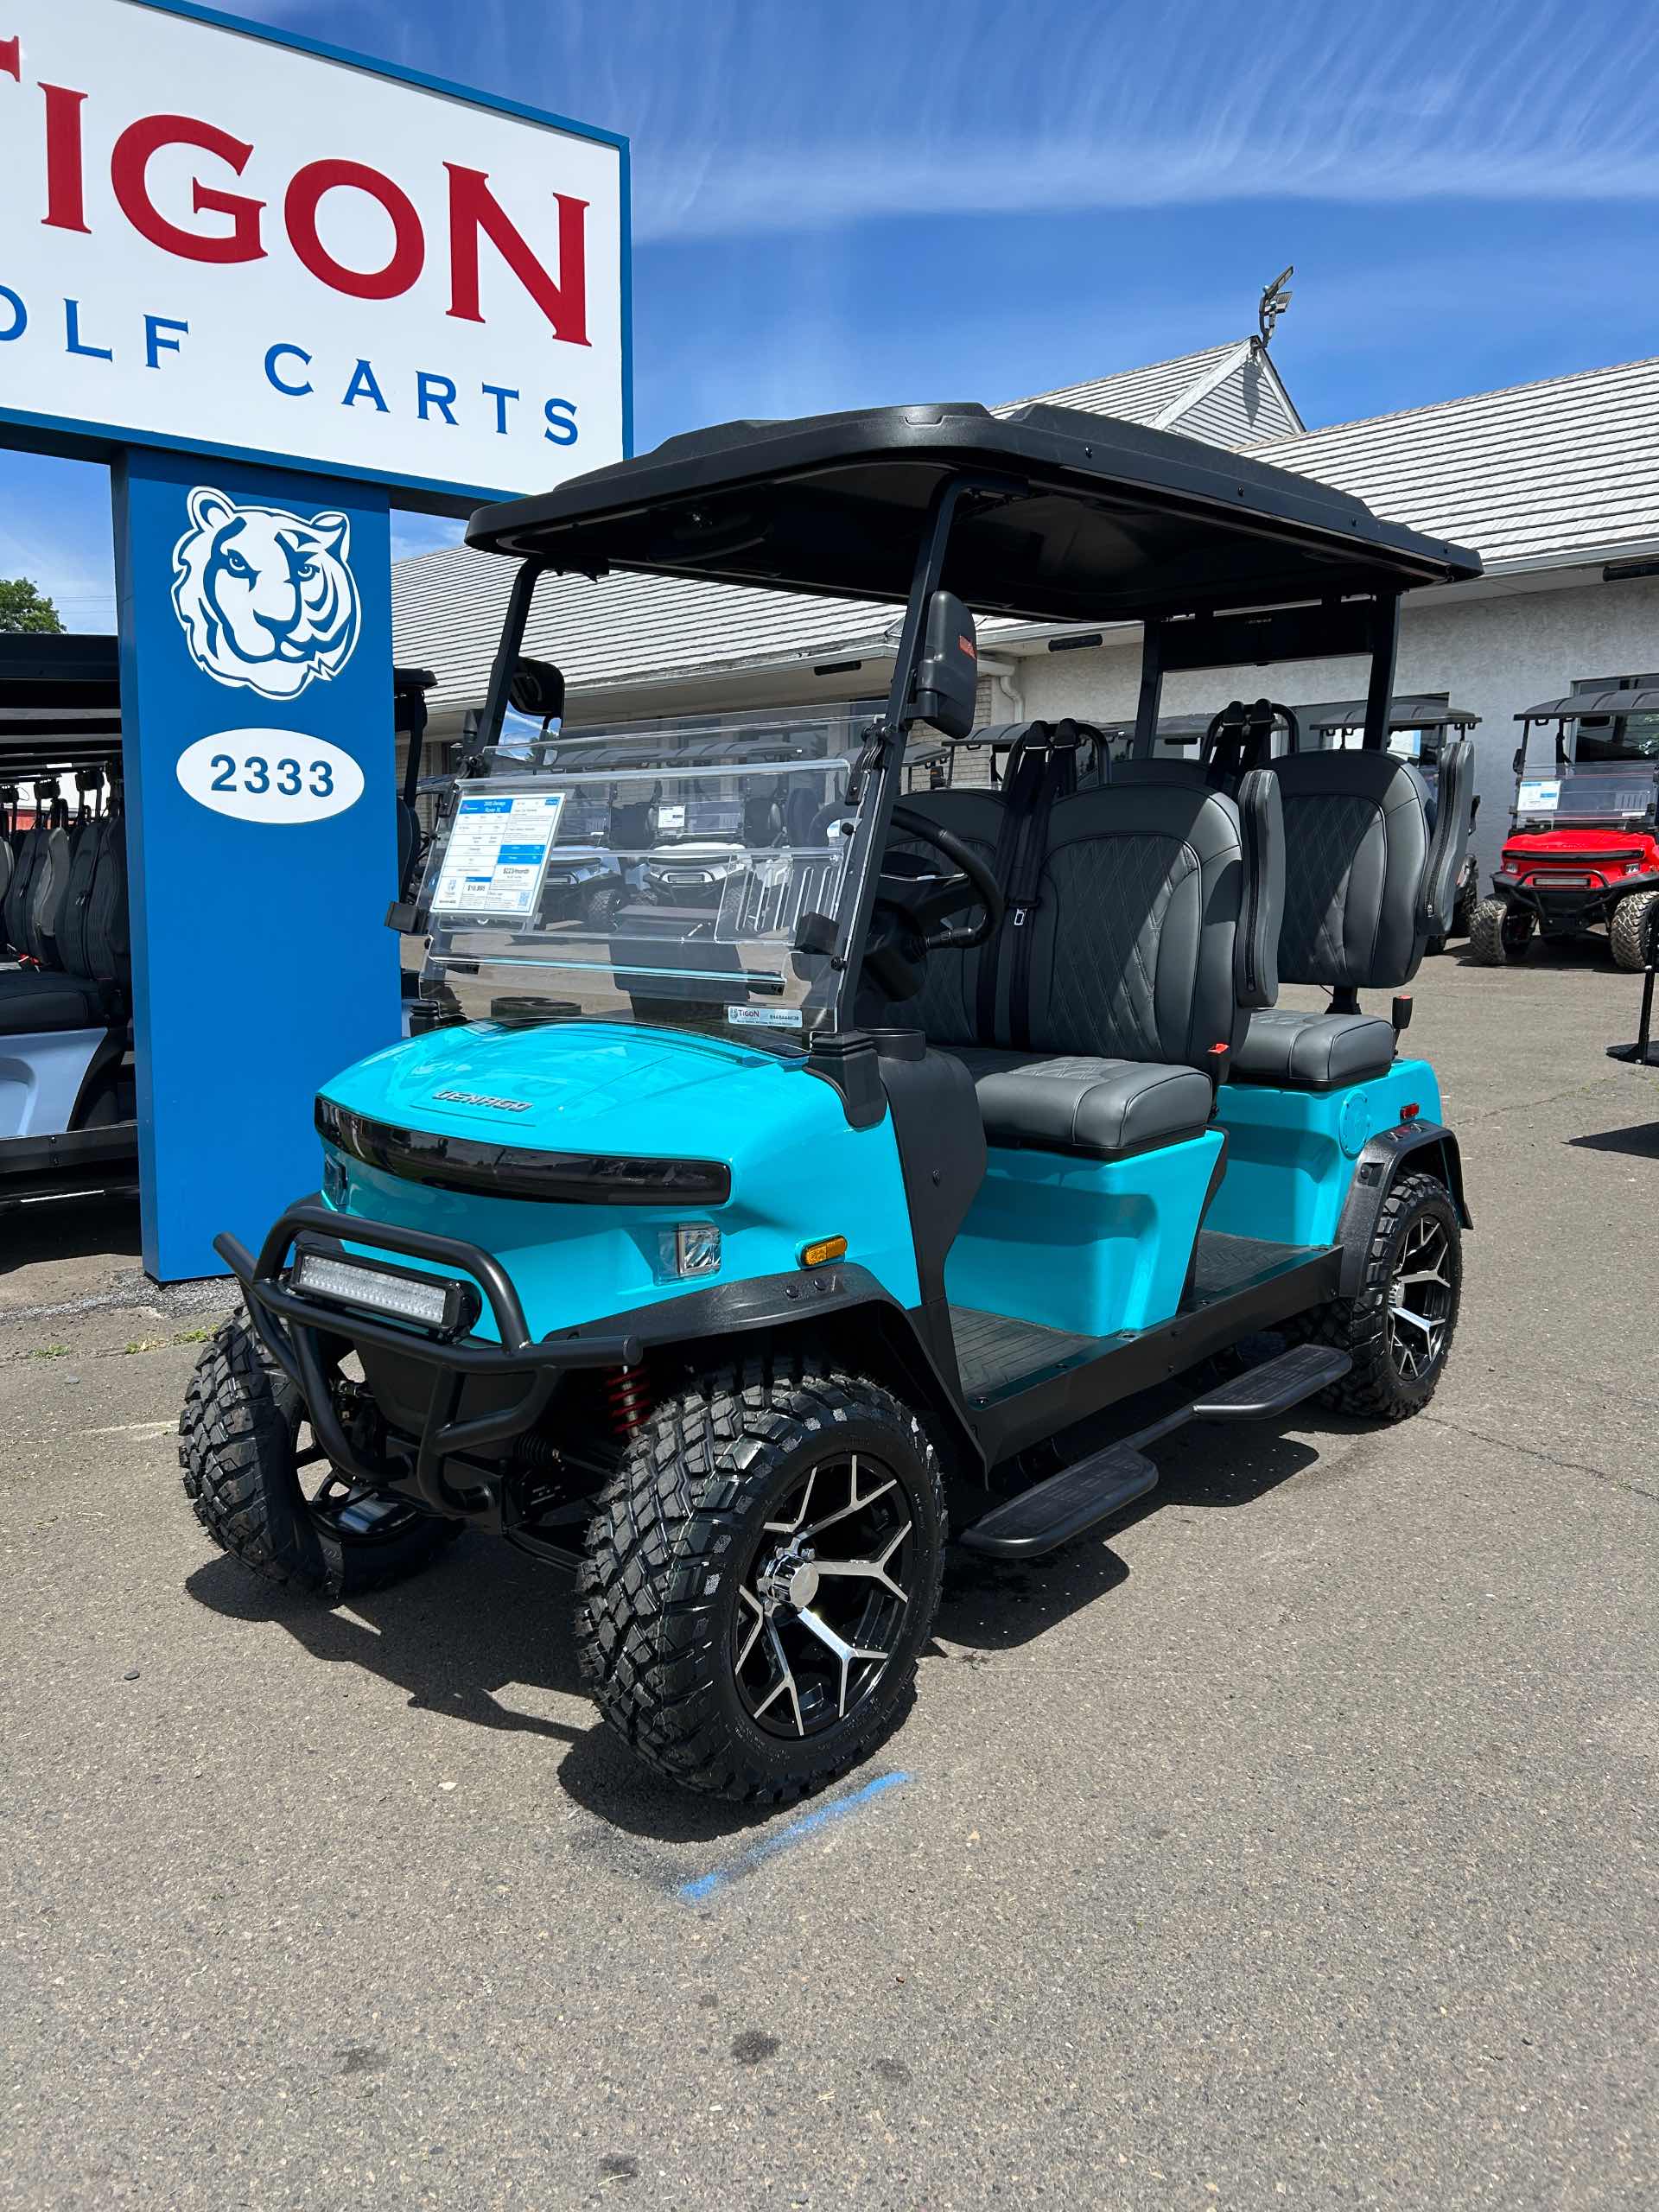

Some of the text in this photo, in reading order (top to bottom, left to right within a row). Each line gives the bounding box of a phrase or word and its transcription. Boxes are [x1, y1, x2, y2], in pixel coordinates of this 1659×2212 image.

[0, 35, 593, 347] IGON
[264, 342, 579, 447] CARTS
[210, 753, 334, 798] 2333
[738, 1008, 760, 1018] TIGON
[432, 1090, 533, 1113] DENAGO
